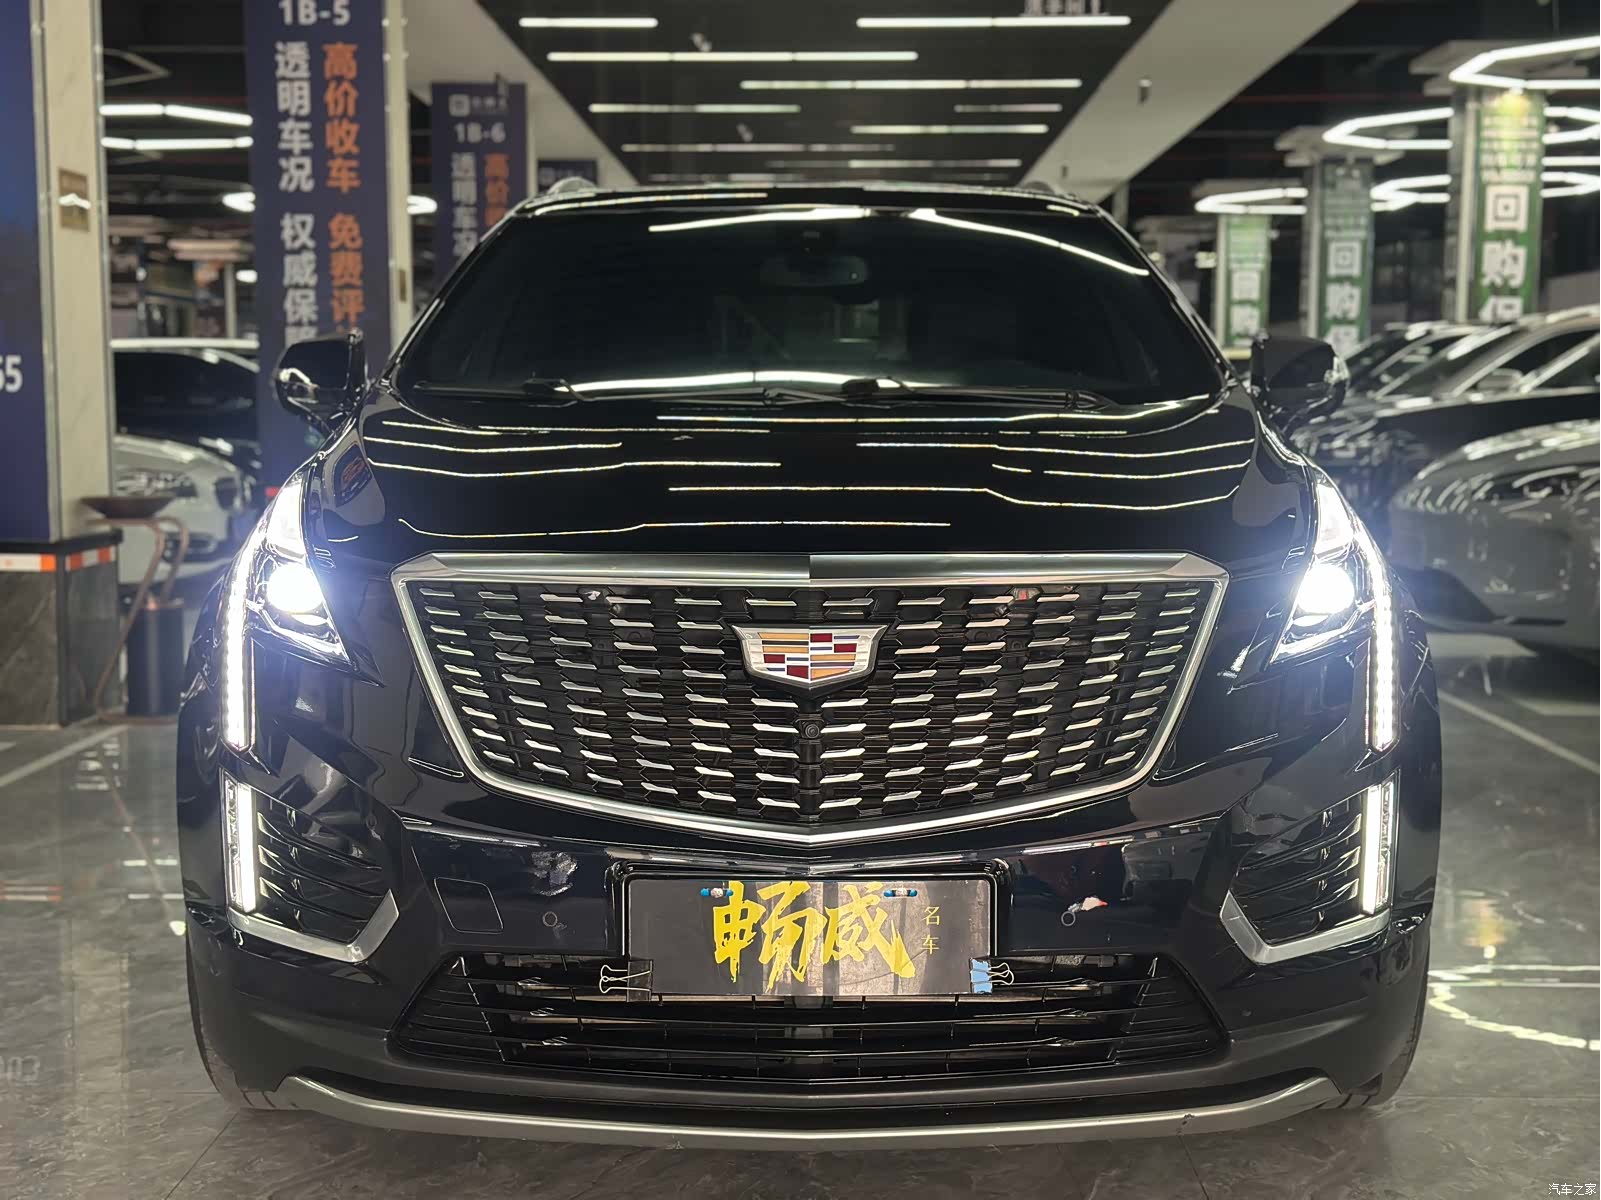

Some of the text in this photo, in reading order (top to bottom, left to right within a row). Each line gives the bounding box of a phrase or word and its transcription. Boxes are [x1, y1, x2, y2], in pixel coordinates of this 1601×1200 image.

[279, 0, 351, 26] 1B-5
[275, 41, 315, 192] 透明车况
[322, 41, 365, 335] 高价收车 免费评
[0, 354, 23, 393] 5
[713, 880, 916, 993] 畅威
[920, 906, 940, 955] 名车
